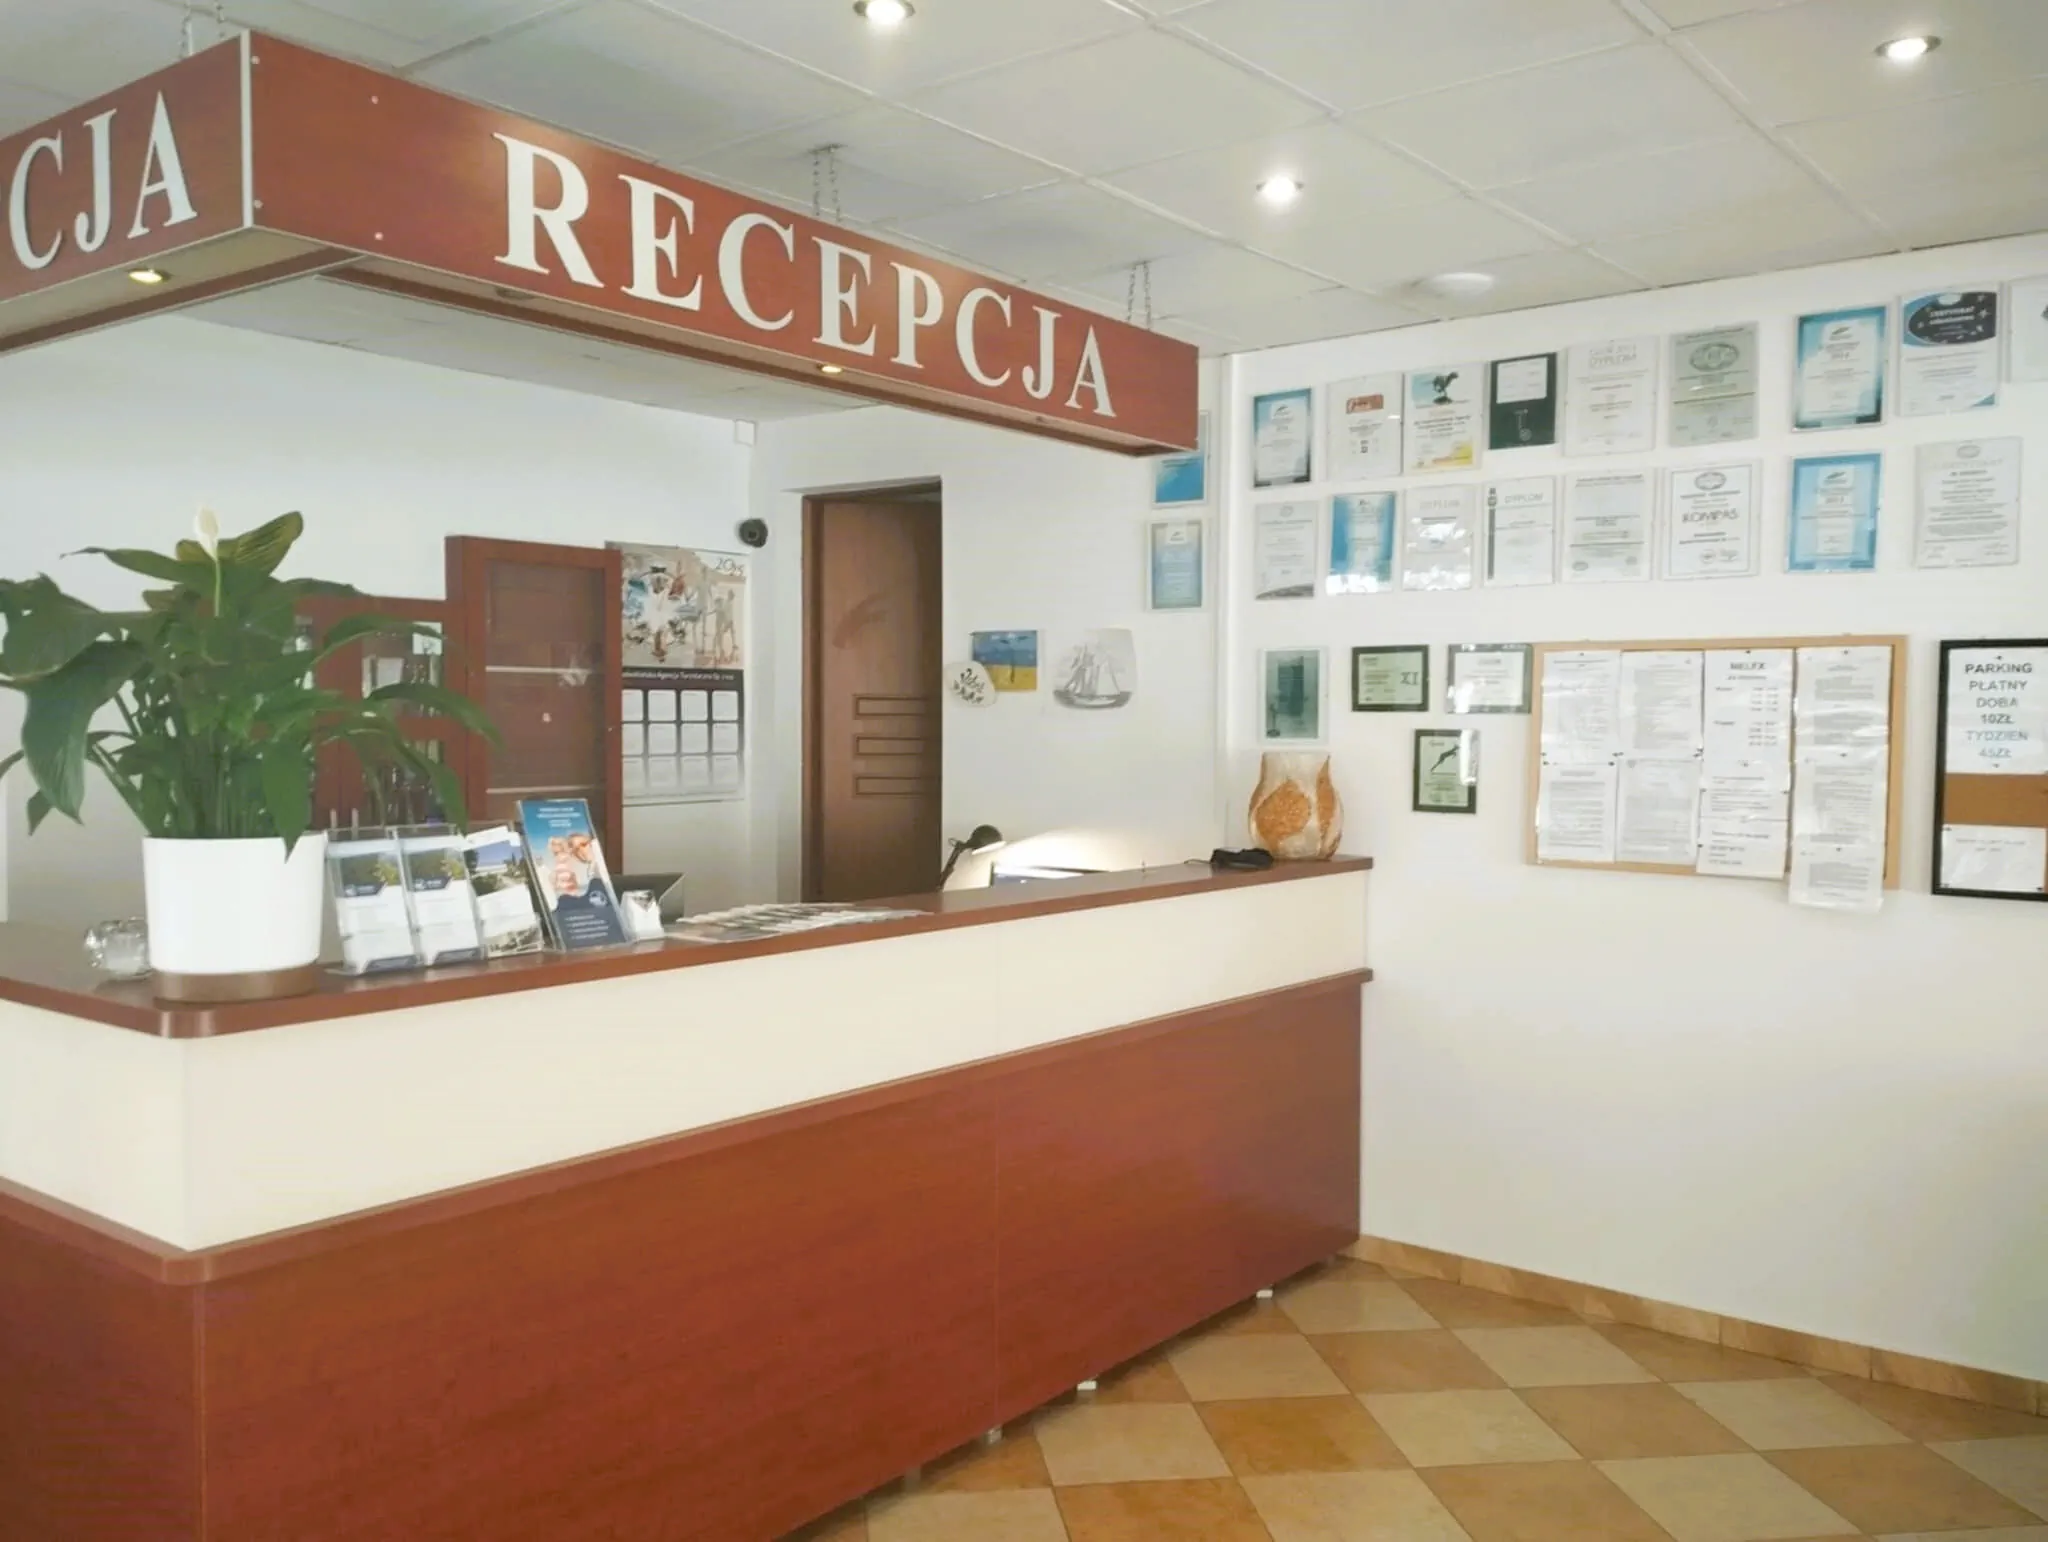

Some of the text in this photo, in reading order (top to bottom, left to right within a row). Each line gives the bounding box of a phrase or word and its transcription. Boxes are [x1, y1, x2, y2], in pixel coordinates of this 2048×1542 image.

[492, 131, 1117, 418] RECEPCJA
[1964, 662, 2033, 674] PARKING
[1976, 697, 2018, 709] DOBA
